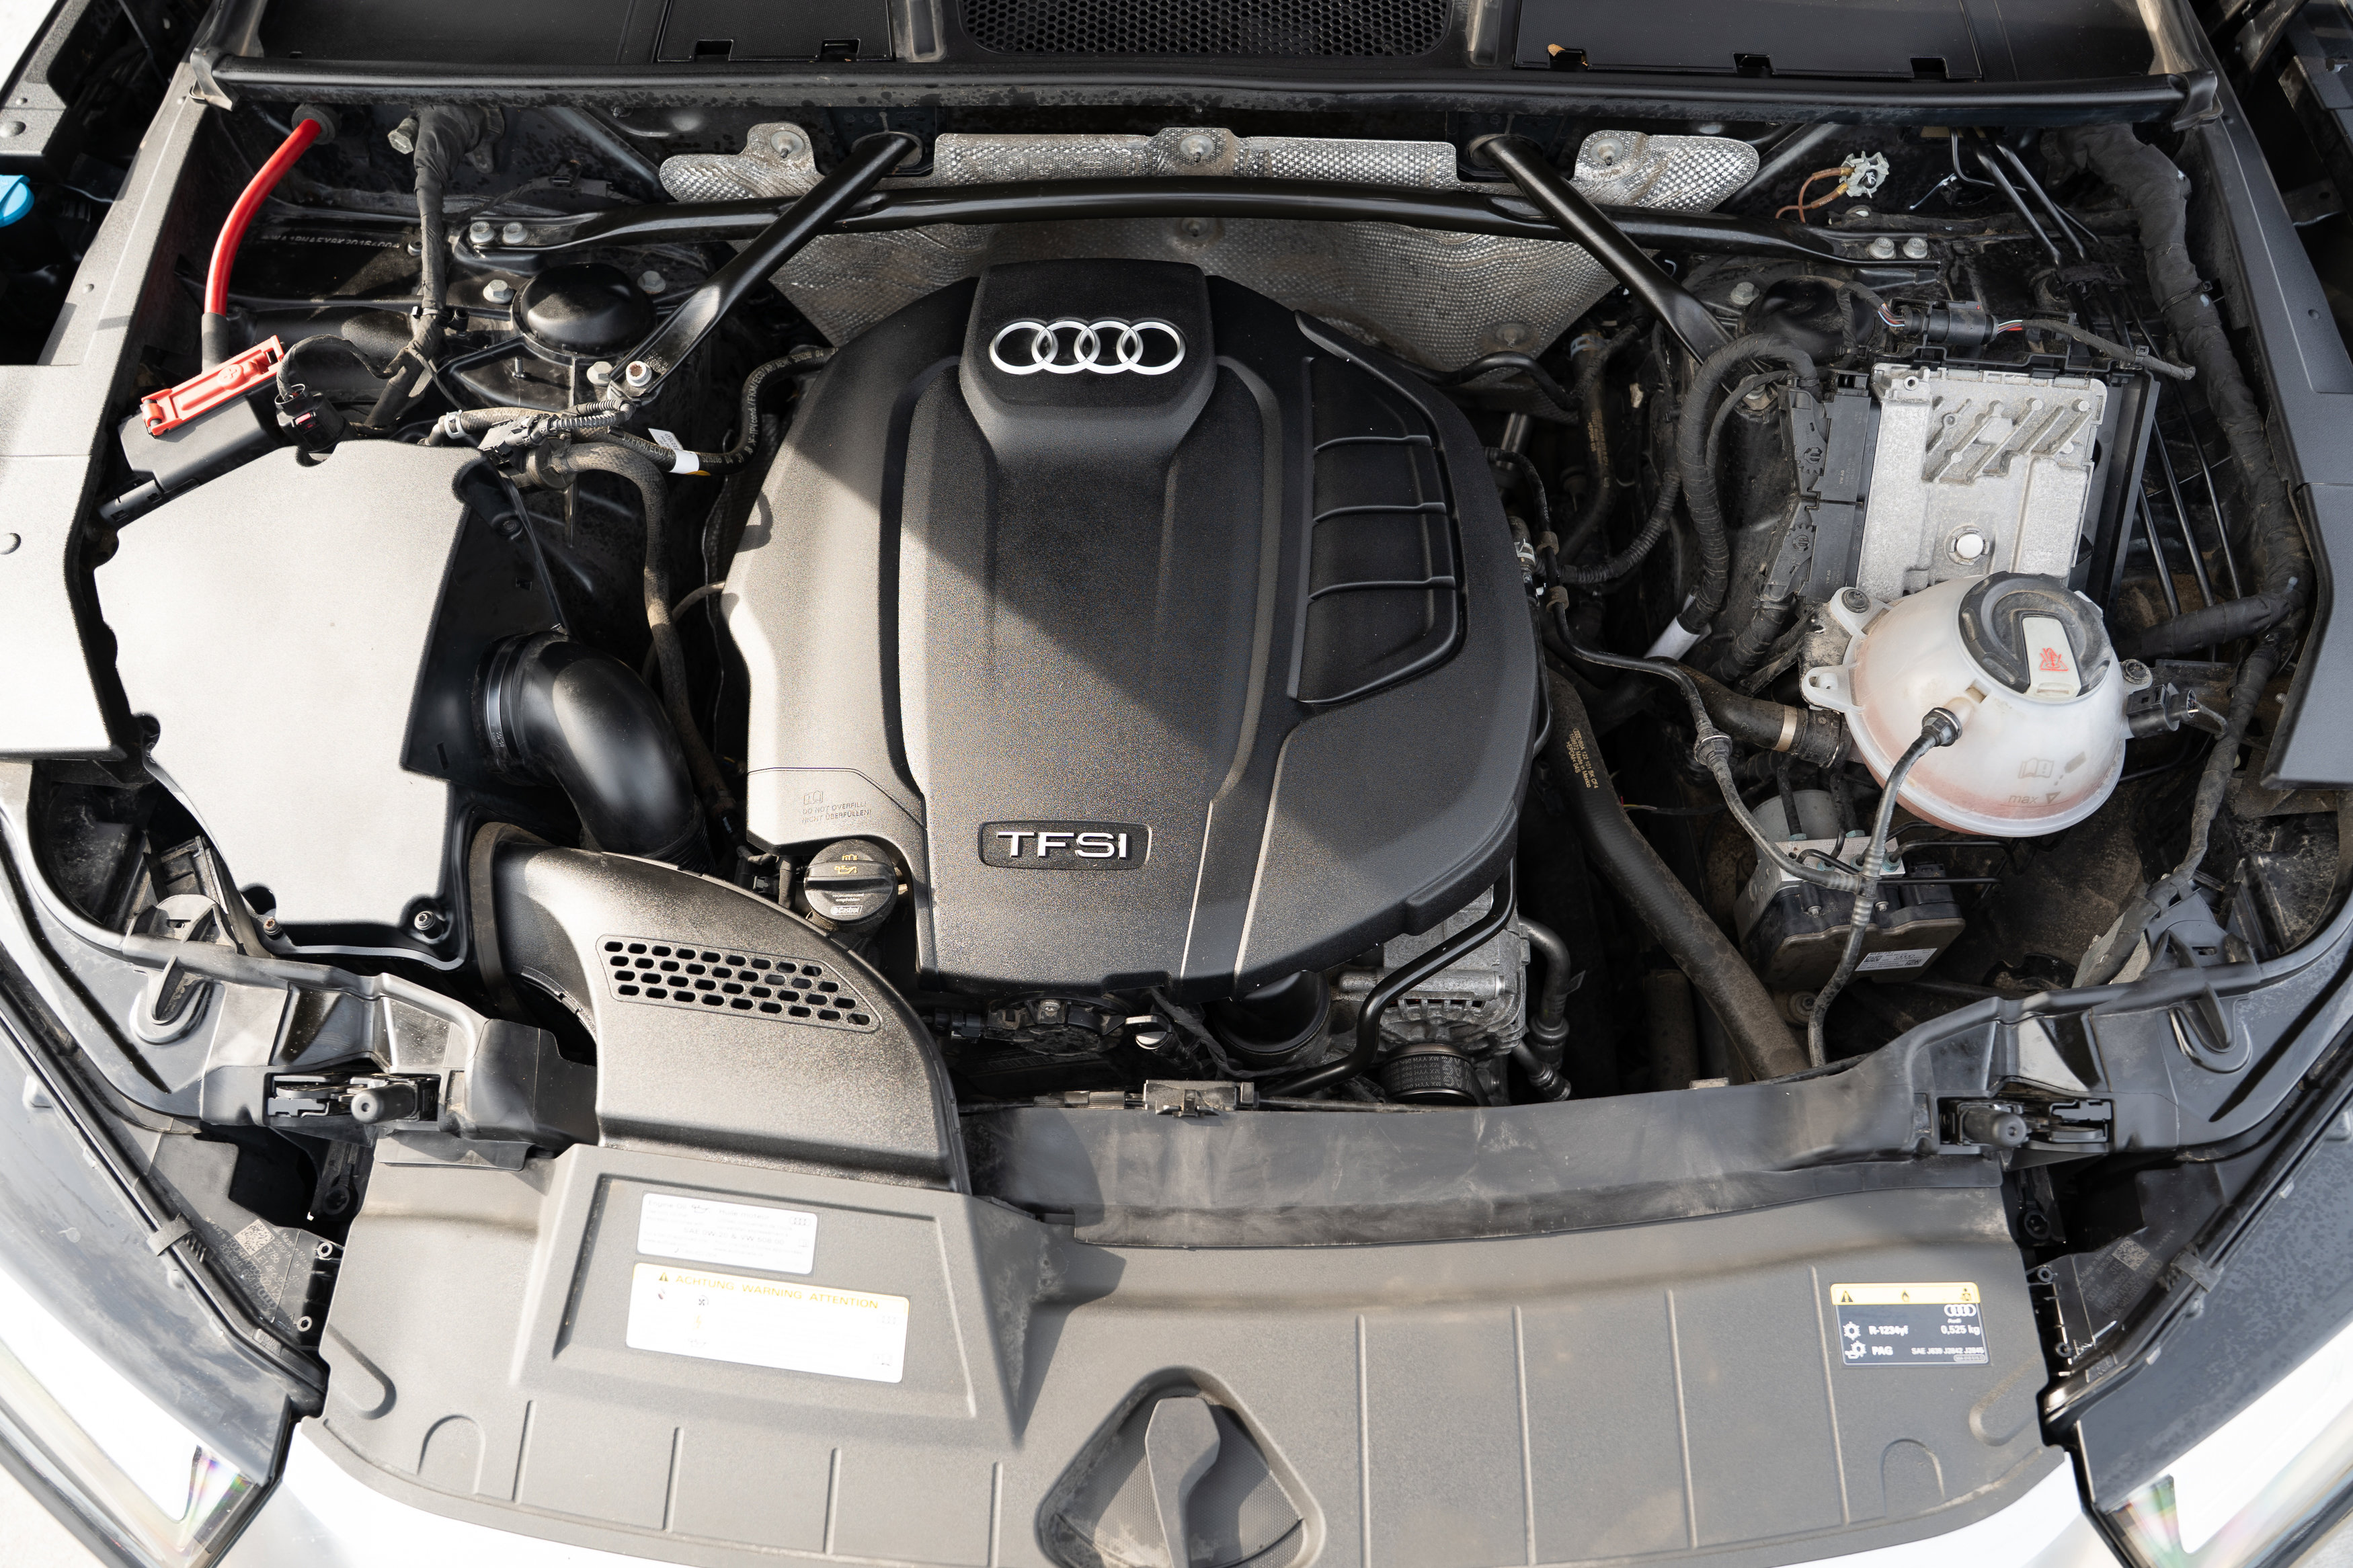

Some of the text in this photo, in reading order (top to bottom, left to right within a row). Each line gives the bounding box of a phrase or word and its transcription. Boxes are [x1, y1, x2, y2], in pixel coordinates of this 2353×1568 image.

[1839, 476, 1843, 484] VW
[1575, 751, 1583, 764] Made
[1581, 770, 1591, 788] Mexico
[2007, 795, 2039, 804] max
[815, 805, 830, 813] NOT
[832, 801, 867, 811] OVERFILL!
[802, 809, 871, 823] NICHT ÜBERFÜLLEN!
[996, 831, 1127, 859] TFSI
[264, 1245, 281, 1264] 3786
[675, 1274, 879, 1310] ACHTUNG WARNING ATTENTION
[1868, 1325, 1981, 1336] R-1234yf 0,525 kg
[1872, 1346, 1893, 1355] PAG
[1911, 1347, 1926, 1355] SAE
